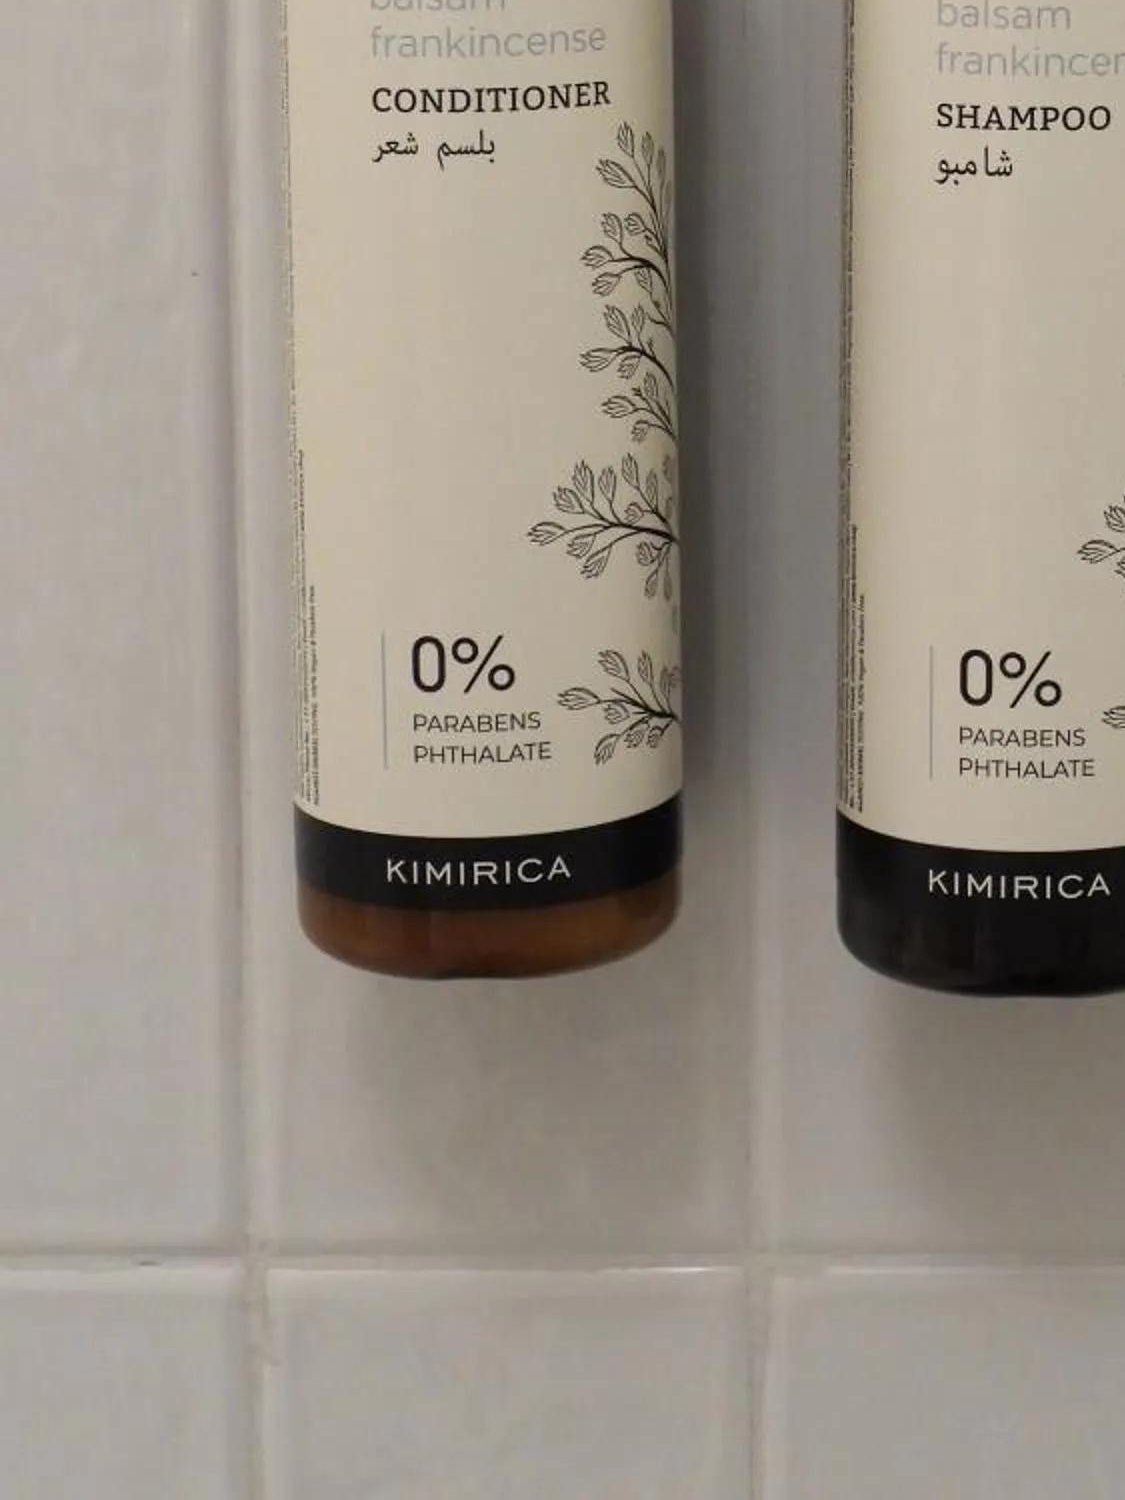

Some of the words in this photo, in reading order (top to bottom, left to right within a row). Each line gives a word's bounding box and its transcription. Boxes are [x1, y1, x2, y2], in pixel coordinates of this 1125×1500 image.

[371, 26, 608, 59] frankincense
[372, 80, 612, 113] CONDITIONER
[937, 103, 1111, 132] SHAMPOO
[372, 132, 419, 163] شعر
[437, 129, 495, 170] بلسم
[935, 146, 1013, 186] شامبو
[411, 634, 516, 694] 0%
[959, 649, 1062, 709] 0%
[413, 711, 541, 733] PARABENS
[959, 726, 1086, 748] PARABENS
[414, 741, 552, 765] PHTHALATE
[959, 757, 1095, 779] PHTHALATE
[386, 855, 572, 886] KIMIRICA
[928, 868, 1111, 899] KIMIRICA
